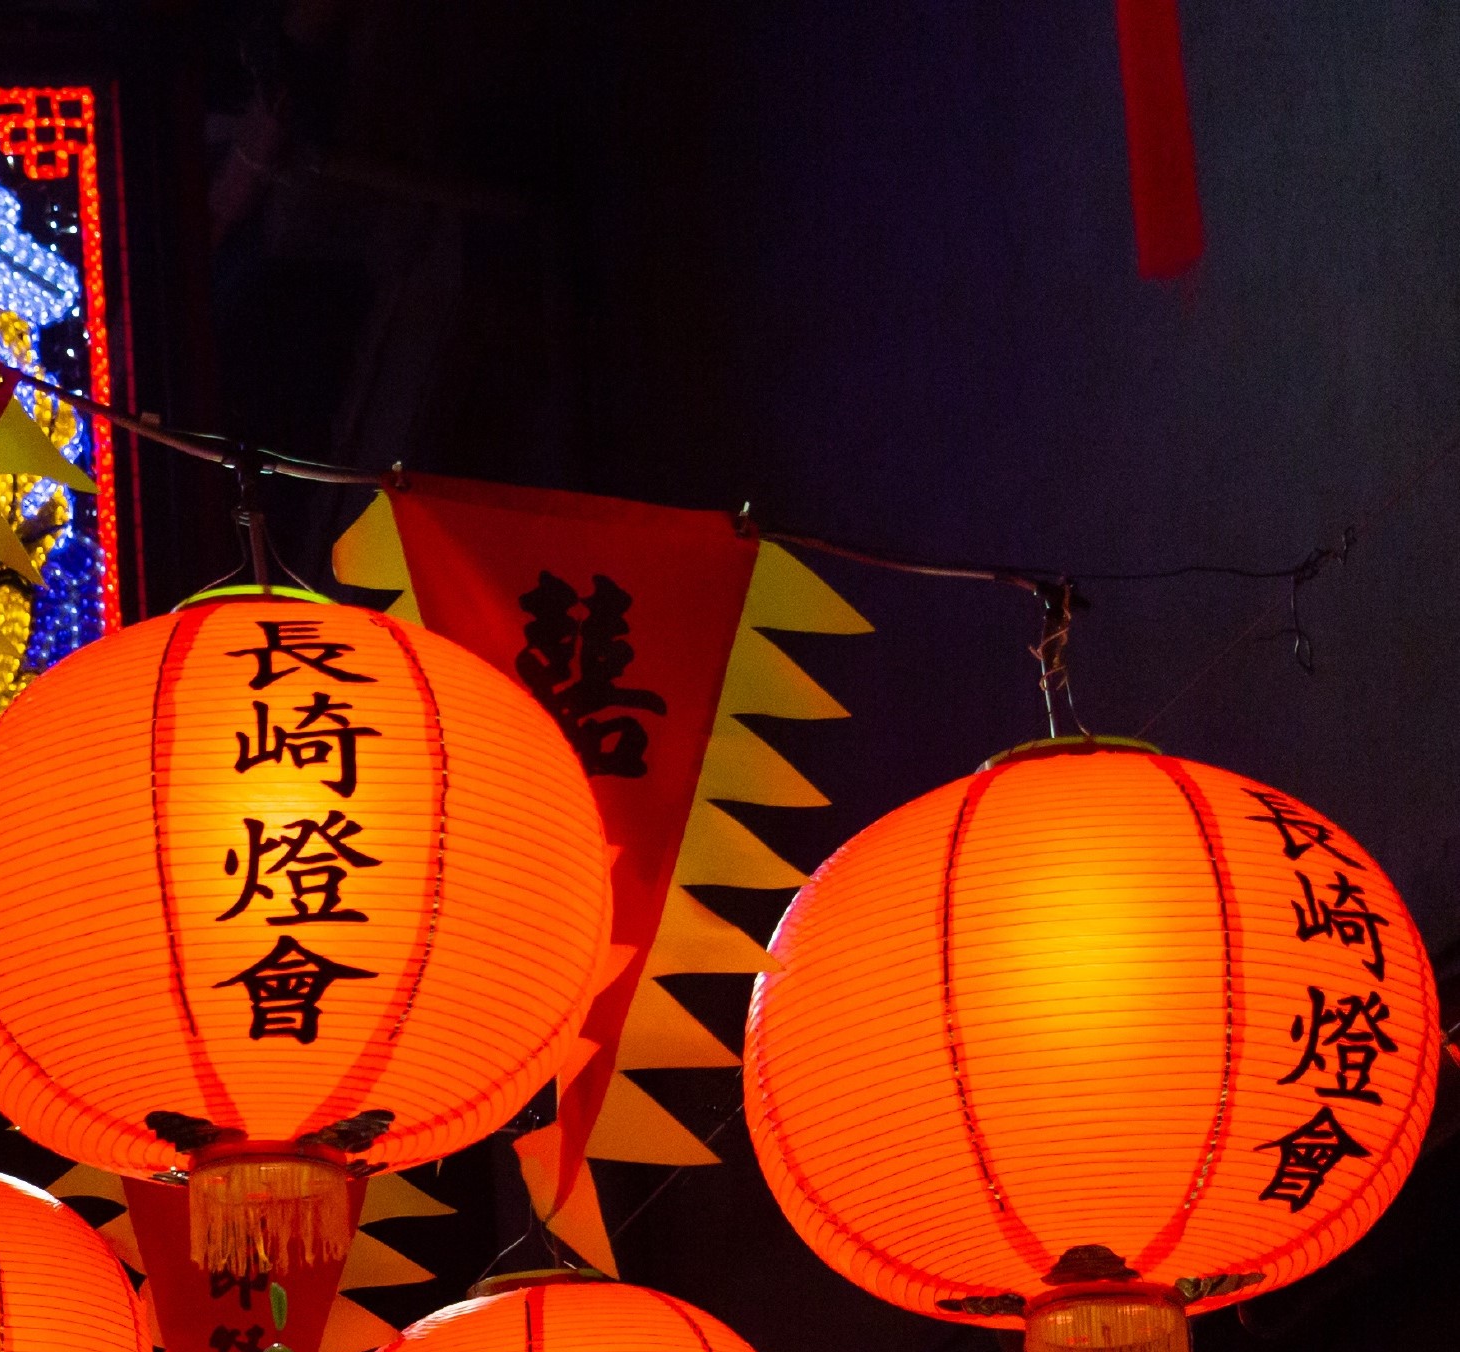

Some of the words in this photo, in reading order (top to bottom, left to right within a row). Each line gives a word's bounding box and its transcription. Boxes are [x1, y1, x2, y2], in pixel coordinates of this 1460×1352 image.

[212, 620, 382, 1046] 長崎燈會
[1239, 786, 1395, 1213] 長崎燈會
